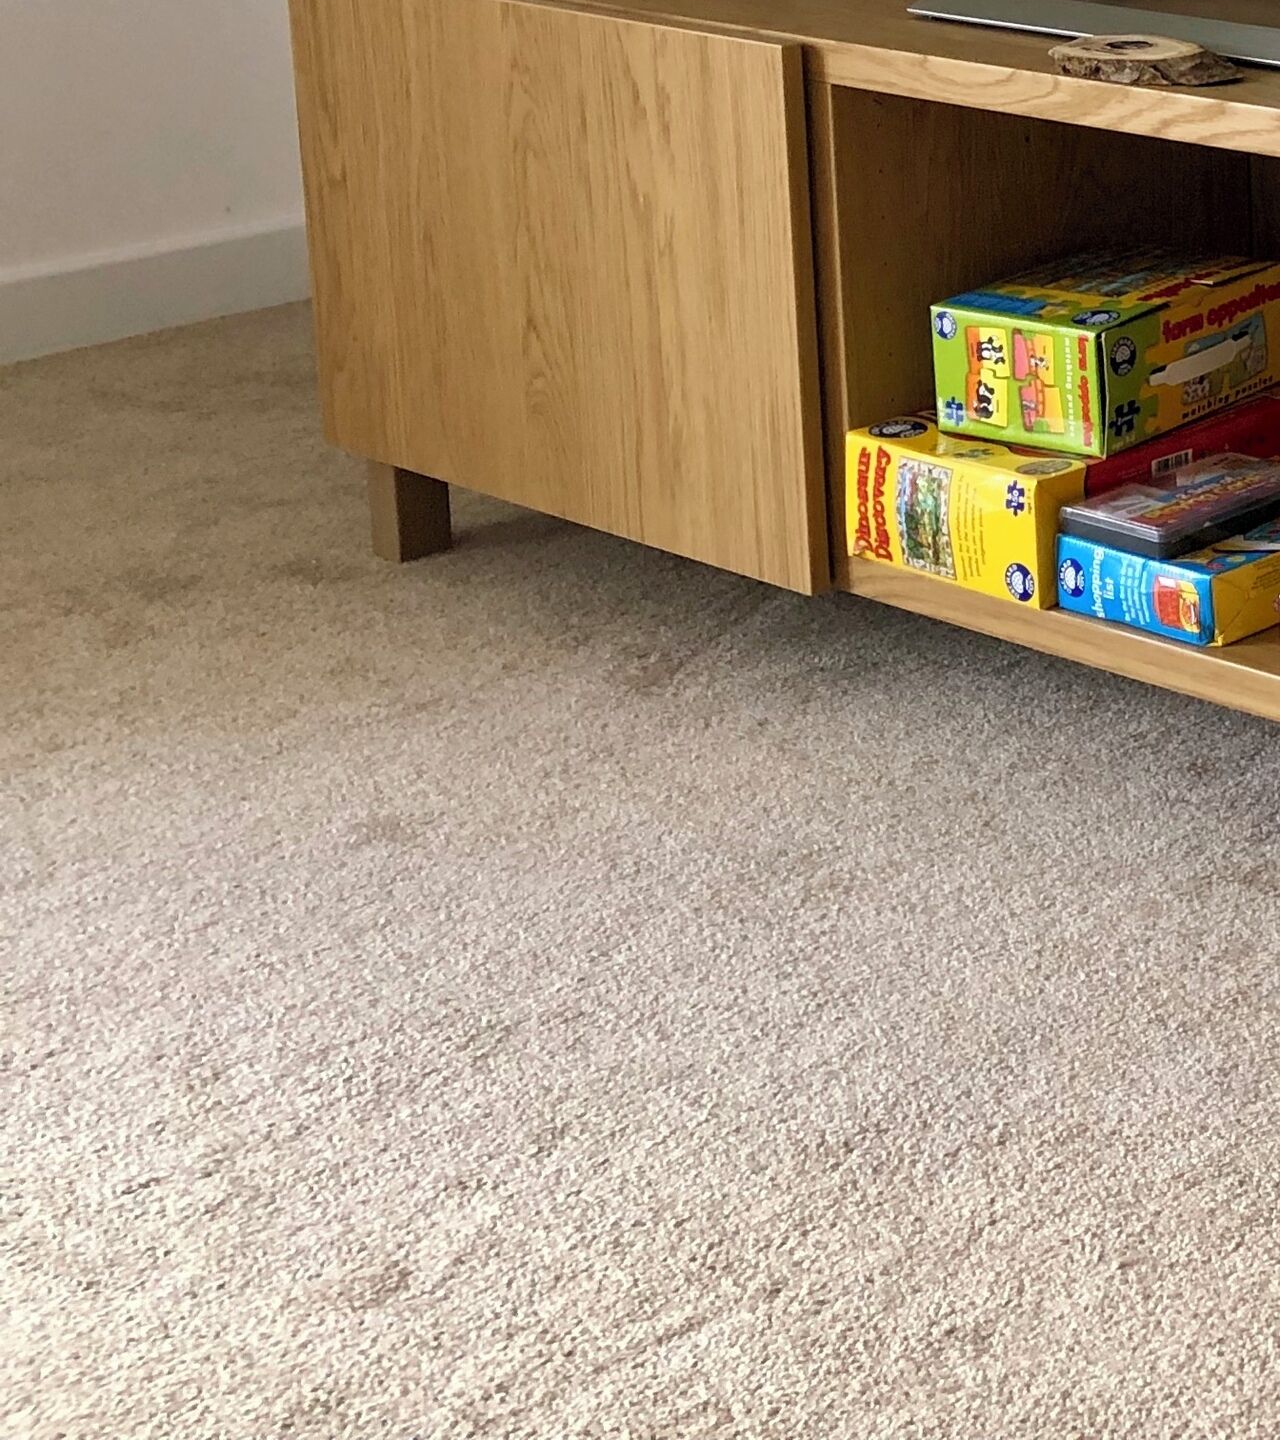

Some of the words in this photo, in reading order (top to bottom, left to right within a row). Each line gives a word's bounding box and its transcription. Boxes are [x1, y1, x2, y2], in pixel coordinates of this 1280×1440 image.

[873, 445, 893, 562] Discovery
[1091, 547, 1106, 619] shopping
[1103, 576, 1115, 601] list
